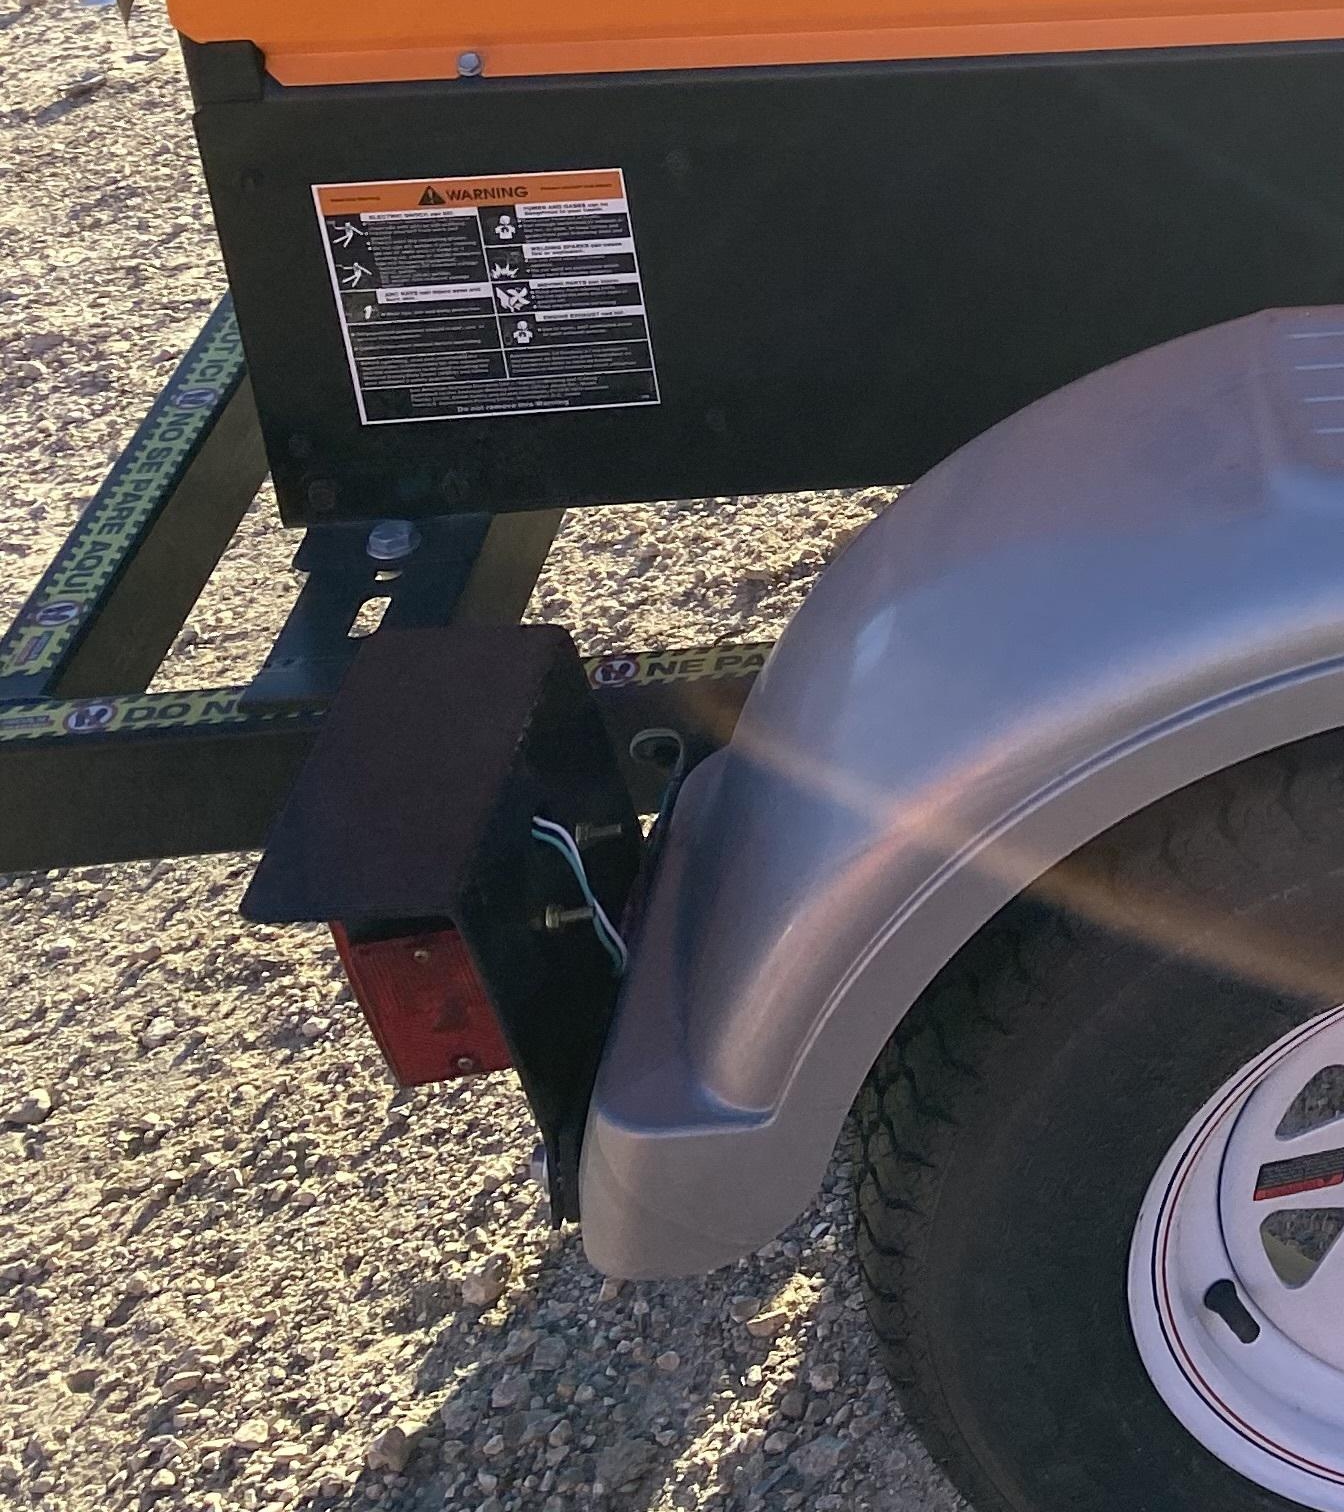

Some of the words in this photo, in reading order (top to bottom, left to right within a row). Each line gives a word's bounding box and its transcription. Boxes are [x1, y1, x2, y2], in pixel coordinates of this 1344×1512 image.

[445, 186, 529, 201] WARNING
[158, 412, 195, 442] NO
[135, 446, 174, 474] SE
[97, 478, 154, 536] PARE
[646, 658, 706, 677] NE
[121, 703, 192, 723] DO
